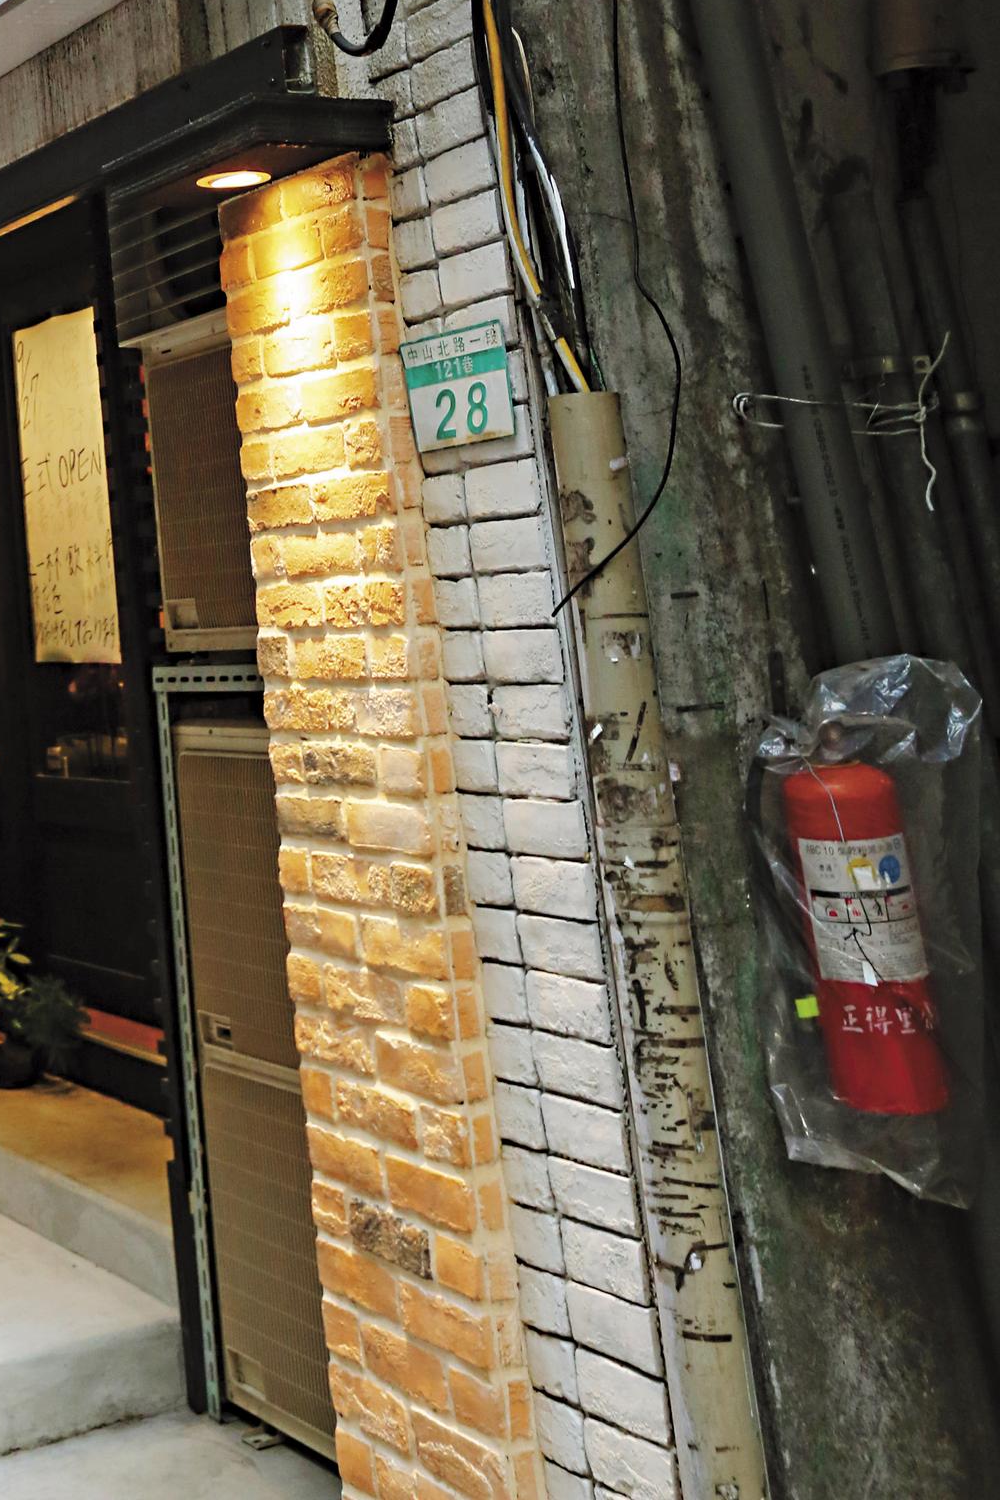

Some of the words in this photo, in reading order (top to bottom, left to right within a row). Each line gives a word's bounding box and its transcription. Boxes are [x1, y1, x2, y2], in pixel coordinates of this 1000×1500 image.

[407, 324, 498, 364] 中山北路一段
[435, 356, 473, 381] 121巷
[435, 380, 489, 441] 28
[58, 443, 103, 489] OPEN
